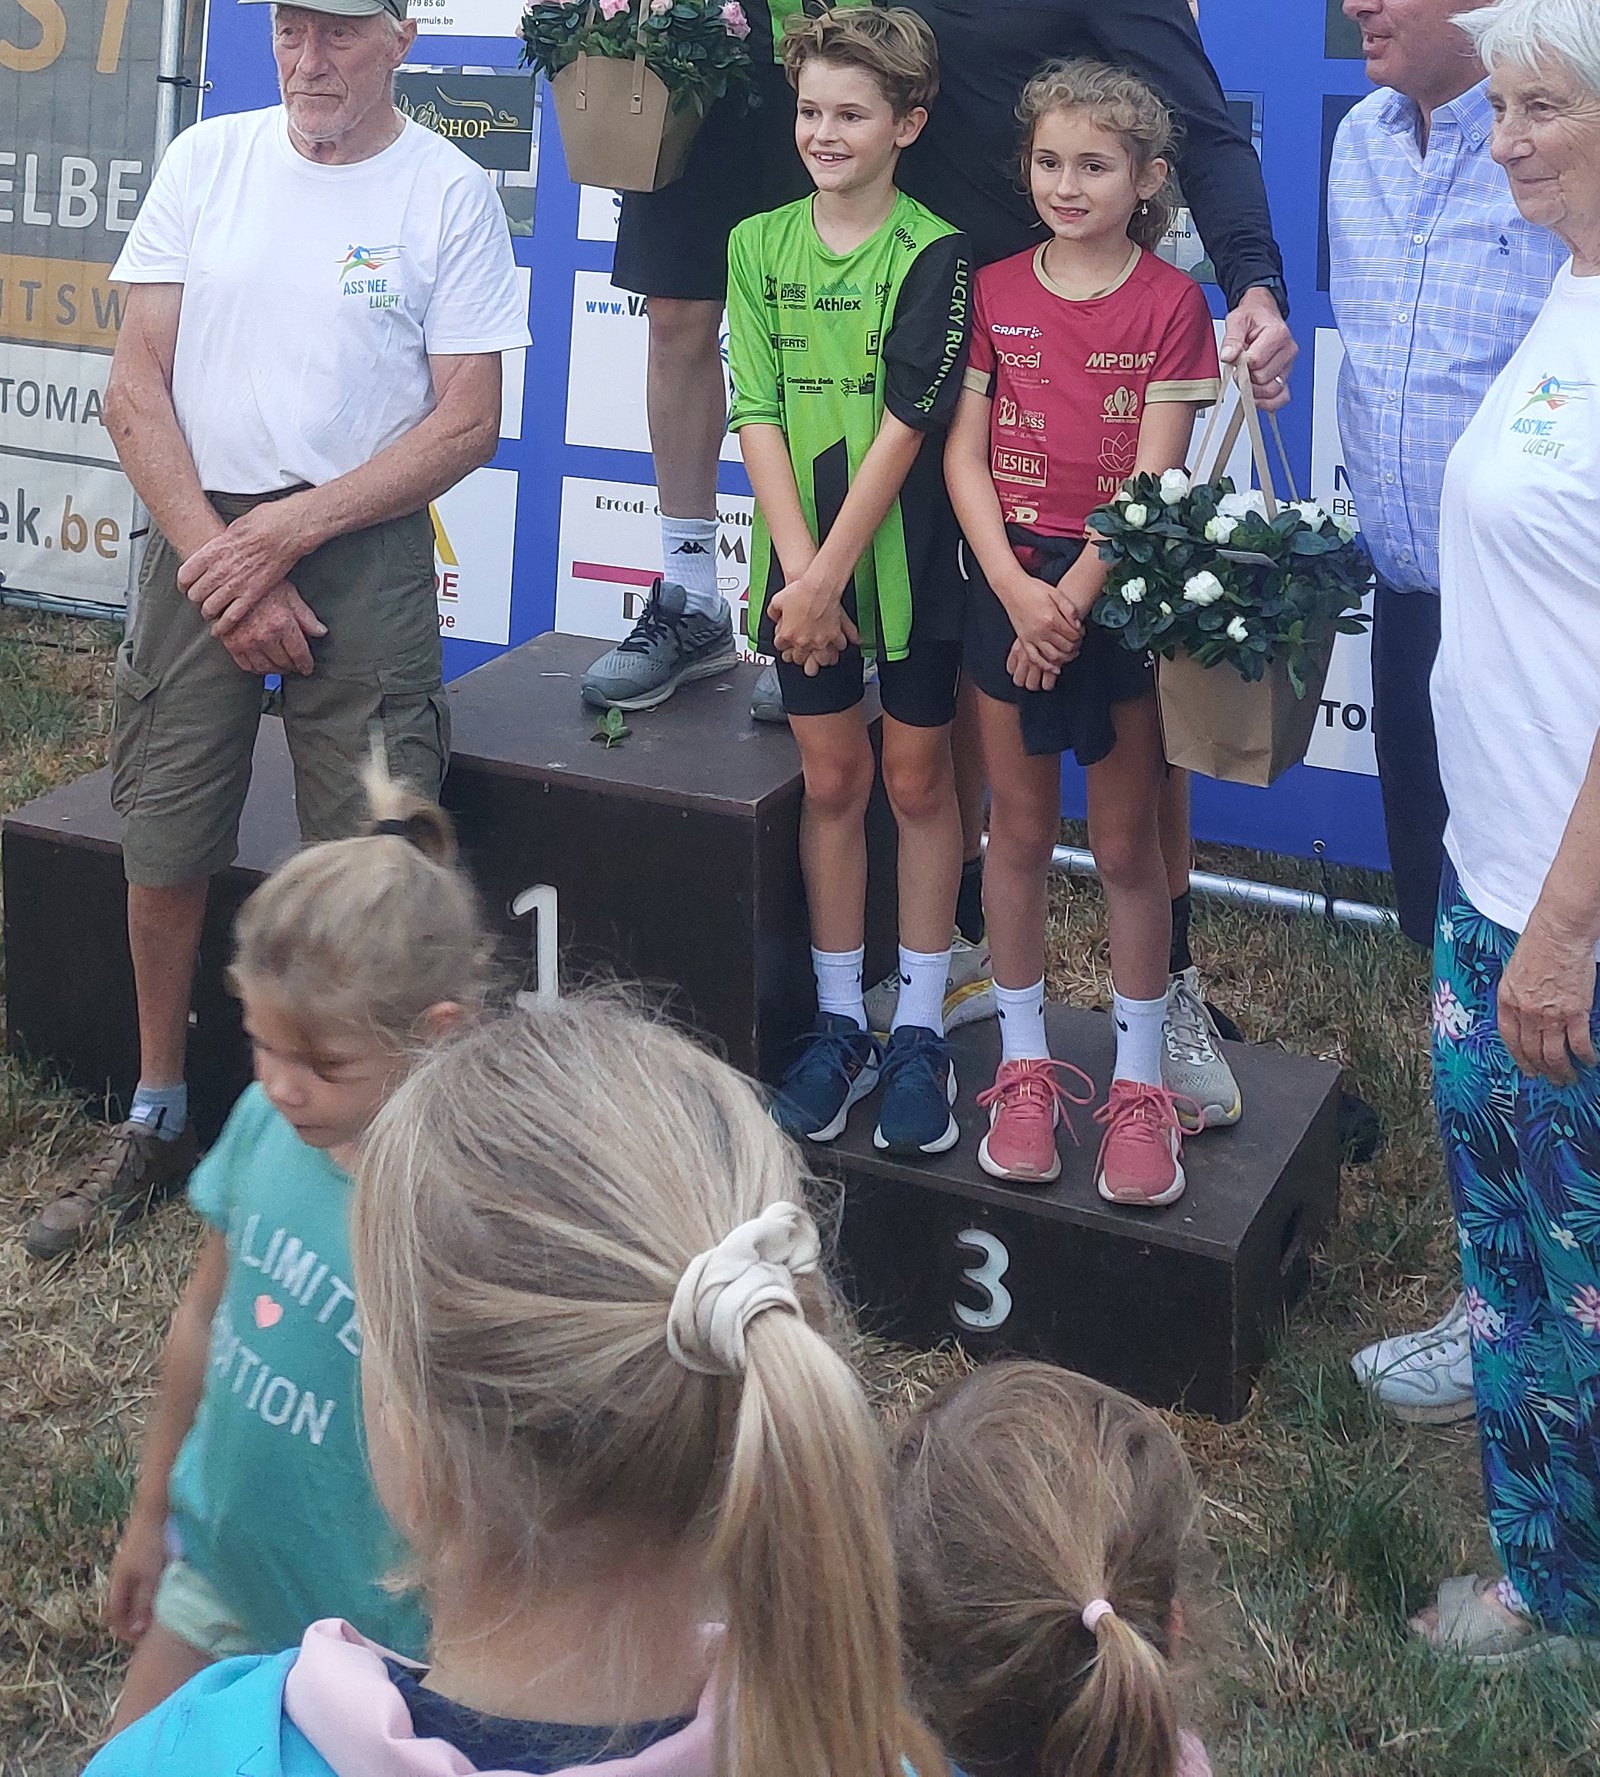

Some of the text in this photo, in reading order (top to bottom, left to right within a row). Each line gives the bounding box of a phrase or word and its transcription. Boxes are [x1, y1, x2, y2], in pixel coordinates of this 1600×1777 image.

[423, 0, 433, 7] 85
[435, 0, 446, 7] 60
[438, 119, 490, 139] SHOP
[1167, 230, 1192, 239] emo
[343, 279, 388, 296] ASS'NEE
[948, 258, 969, 327] LUCKY
[0, 273, 126, 331] TSW
[813, 297, 862, 311] Athlex
[991, 324, 1031, 337] CRAFT
[1319, 699, 1373, 733] TO
[512, 883, 559, 1006] 1
[954, 1227, 1013, 1330] 3
